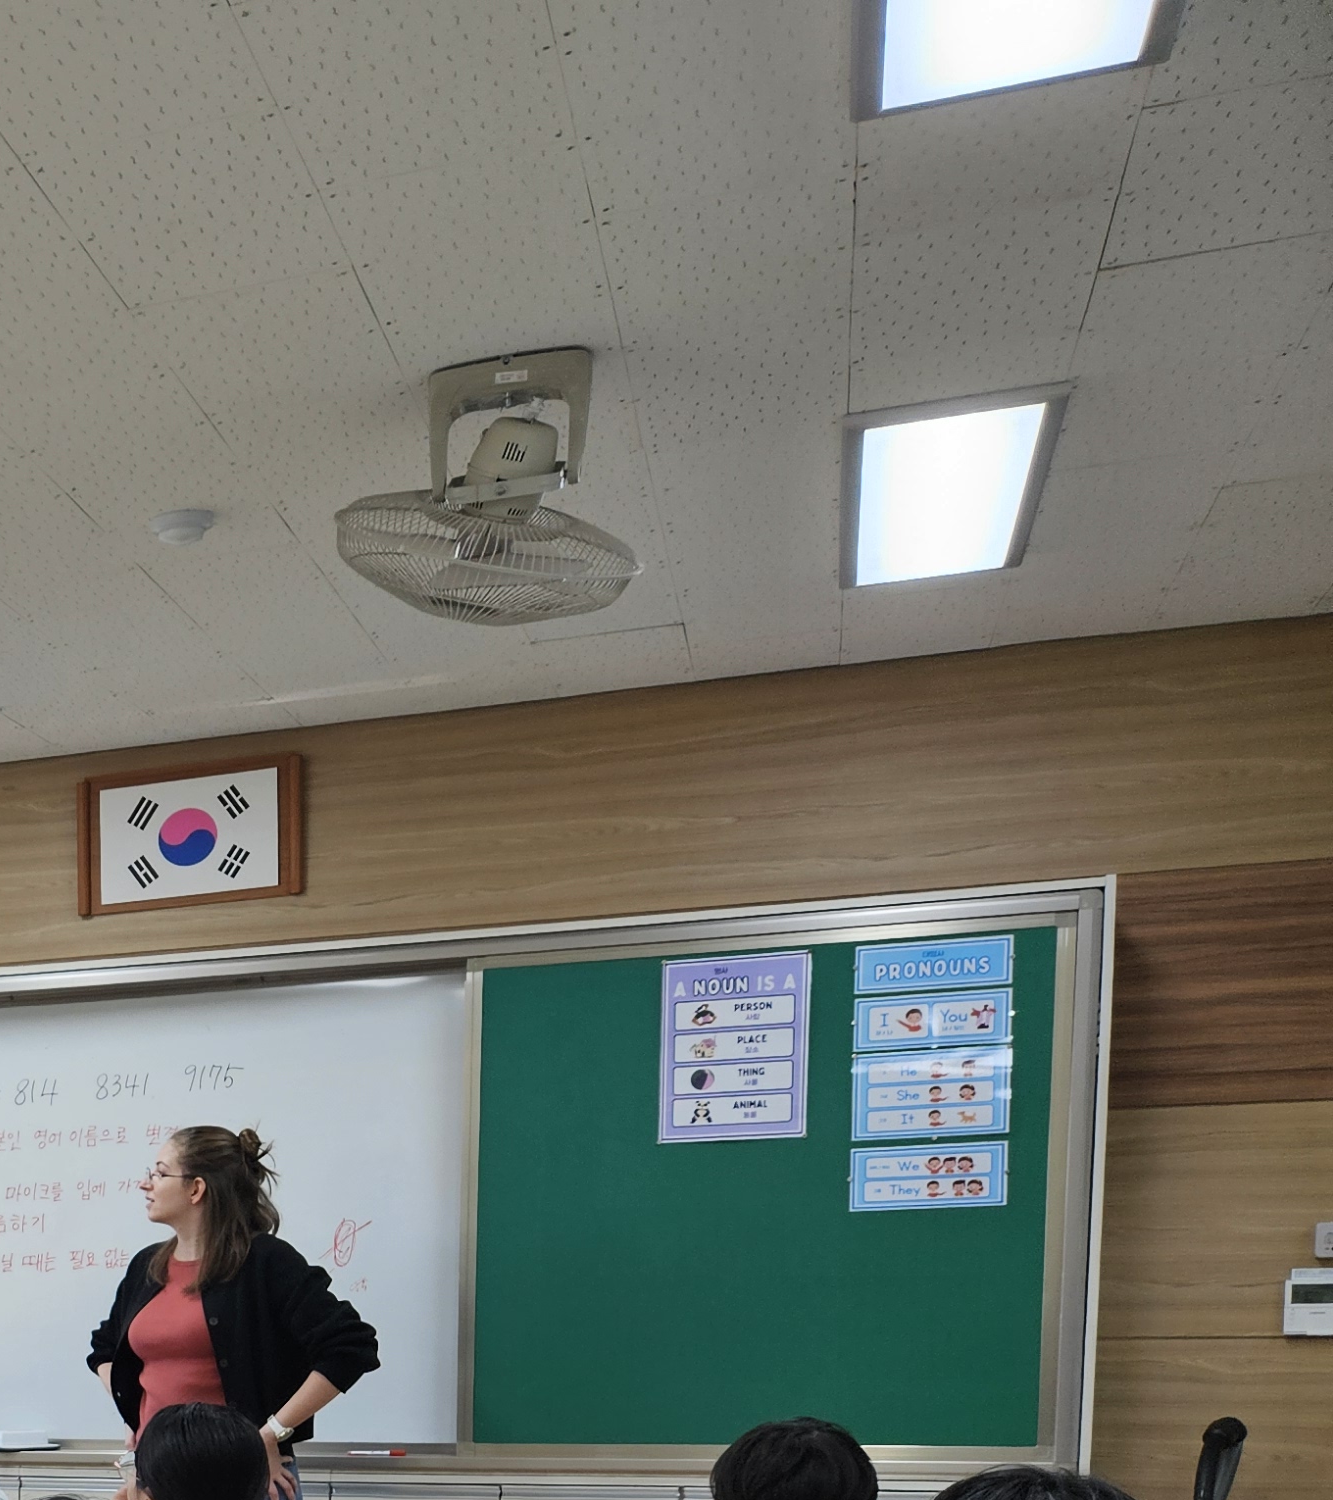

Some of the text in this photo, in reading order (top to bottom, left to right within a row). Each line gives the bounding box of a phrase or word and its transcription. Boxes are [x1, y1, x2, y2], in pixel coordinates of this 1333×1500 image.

[874, 956, 991, 982] PRONOUNS
[674, 973, 796, 998] A NOUN IS A
[734, 1001, 773, 1012] PERSON
[880, 1013, 889, 1028] I
[940, 1009, 968, 1024] You
[737, 1034, 767, 1044] PLACE
[738, 1067, 765, 1077] THING
[900, 1066, 917, 1077] He
[14, 1079, 58, 1105] 814
[96, 1073, 149, 1100] 8341
[184, 1063, 244, 1092] 9175
[897, 1090, 920, 1101] She
[733, 1100, 768, 1110] ANIMAL
[901, 1114, 914, 1125] It
[33, 1128, 62, 1150] 영어
[70, 1125, 129, 1147] 이름으로
[897, 1161, 920, 1171] We
[5, 1182, 63, 1201] 마이크를
[76, 1179, 105, 1200] 입에
[889, 1184, 921, 1197] They
[21, 1252, 56, 1272] 때는
[69, 1249, 98, 1270] 필요
